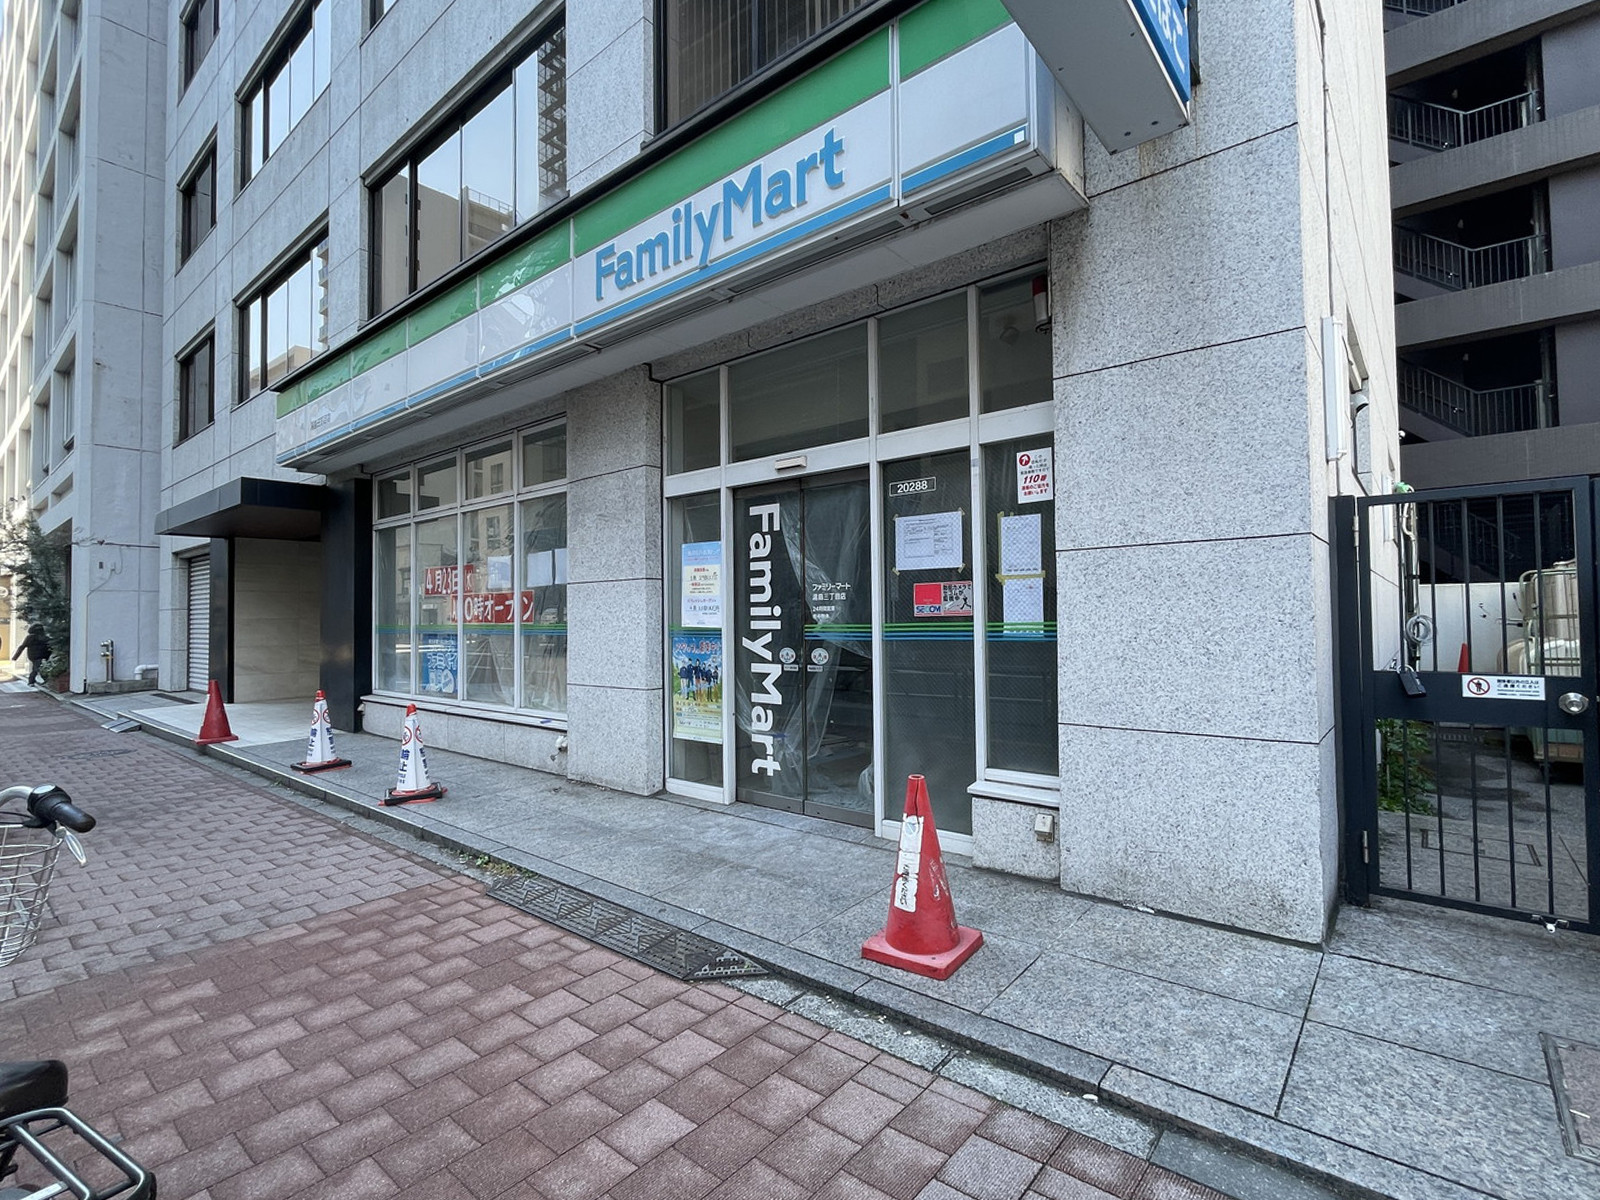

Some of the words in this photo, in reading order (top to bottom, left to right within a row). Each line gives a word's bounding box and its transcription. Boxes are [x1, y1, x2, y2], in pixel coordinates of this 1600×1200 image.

[595, 127, 845, 301] FamilyMart
[897, 480, 928, 494] 20288
[812, 582, 852, 592] ファミリーマート
[915, 605, 942, 614] SECOM
[742, 502, 782, 777] FamilyMart
